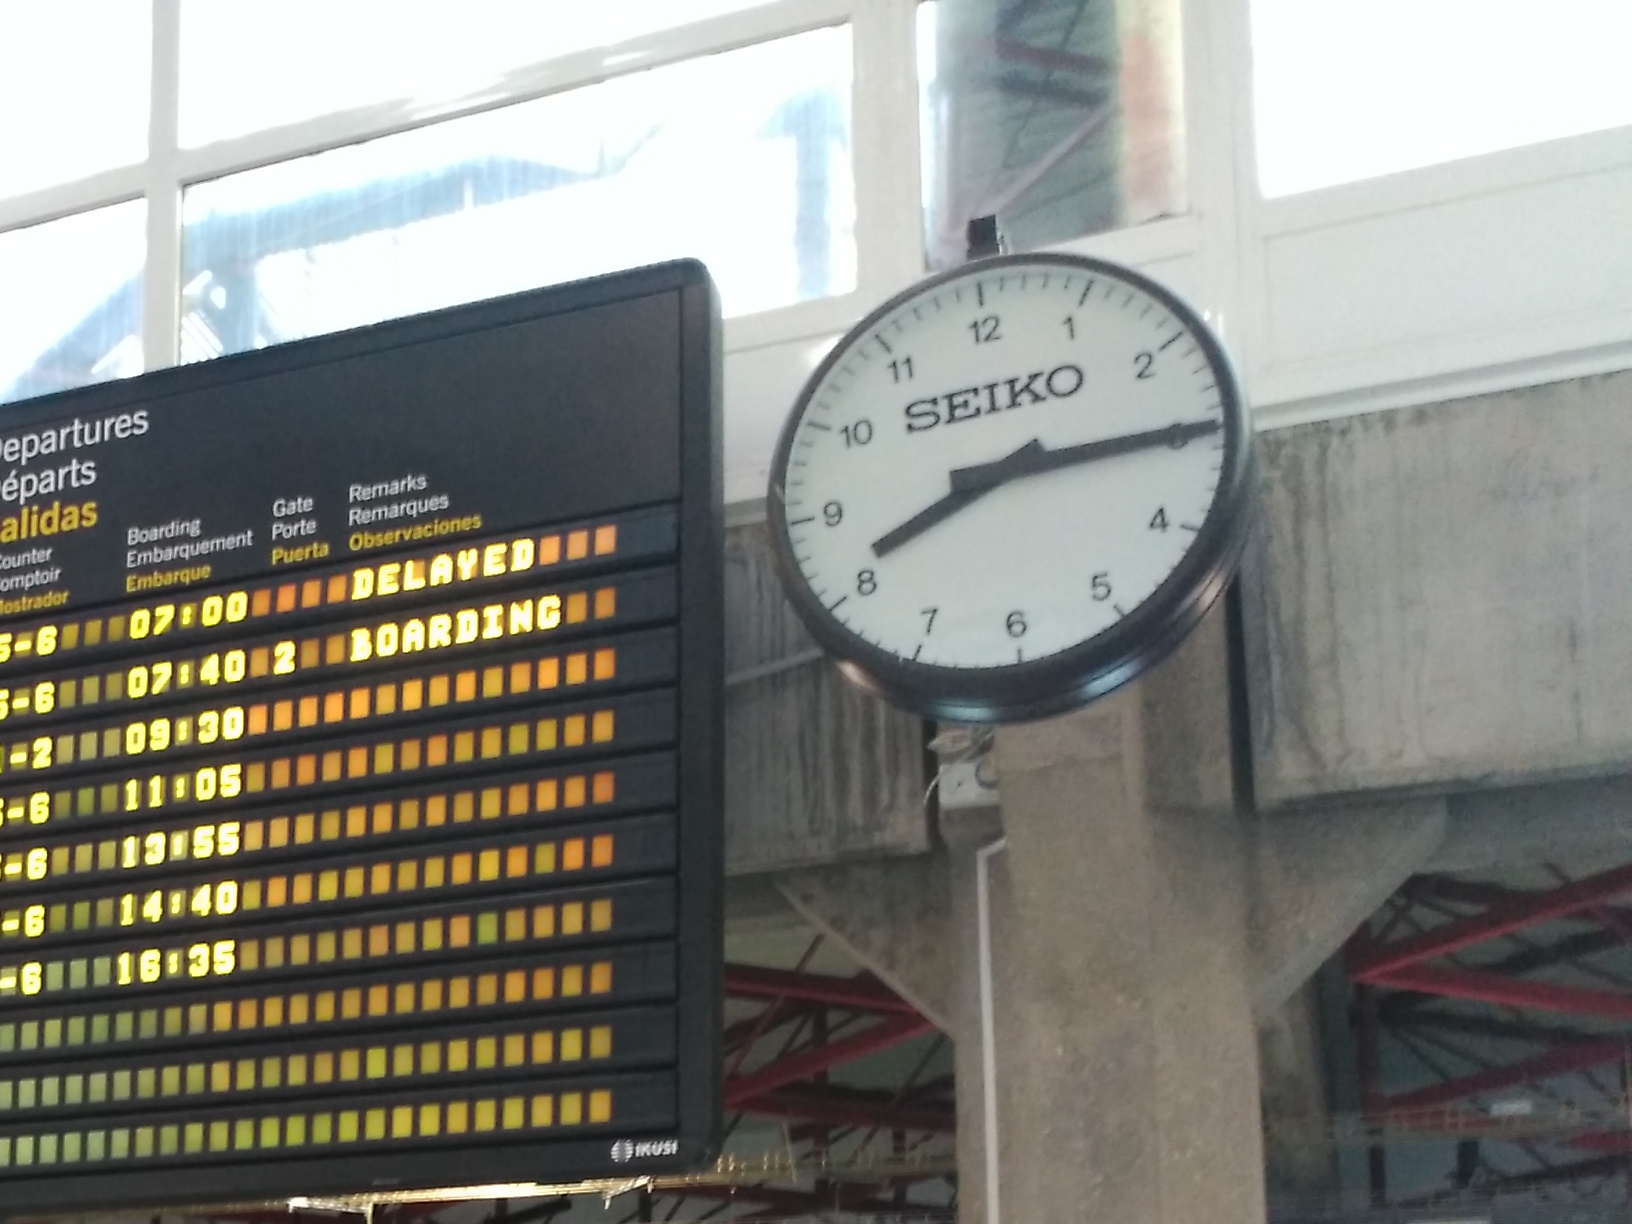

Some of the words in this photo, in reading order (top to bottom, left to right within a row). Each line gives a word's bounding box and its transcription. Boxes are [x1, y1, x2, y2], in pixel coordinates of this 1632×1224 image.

[968, 315, 1002, 344] 12
[1063, 317, 1076, 340] 1
[887, 356, 915, 382] 11
[1133, 353, 1155, 379] 2
[904, 364, 1085, 433] SEIKO
[840, 419, 873, 448] 10
[349, 473, 427, 503] Remarks
[272, 495, 314, 518] Gate
[349, 493, 449, 526] Remarques
[823, 501, 844, 527] 9
[1149, 507, 1169, 534] 4
[127, 518, 202, 546] Boarding
[272, 519, 317, 540] Porte
[349, 514, 482, 551] Observaciones
[126, 529, 254, 568] Embarquement
[272, 541, 329, 565] Puerta
[126, 563, 212, 592] Embarque
[130, 591, 248, 639] 07:00
[351, 538, 534, 601] DELAYED
[857, 570, 878, 596] 8
[1091, 573, 1112, 601] 5
[920, 608, 939, 634] 7
[1006, 610, 1028, 638] 6
[128, 650, 245, 698] 07:40
[273, 641, 295, 675] 2
[350, 594, 561, 662] BOARDING
[126, 706, 244, 755] 09:30
[125, 764, 241, 811] 11:05
[123, 822, 240, 868] 13:55
[121, 881, 238, 926] 14:40
[118, 940, 235, 985] 16:35
[635, 1138, 679, 1158] IKUSI
